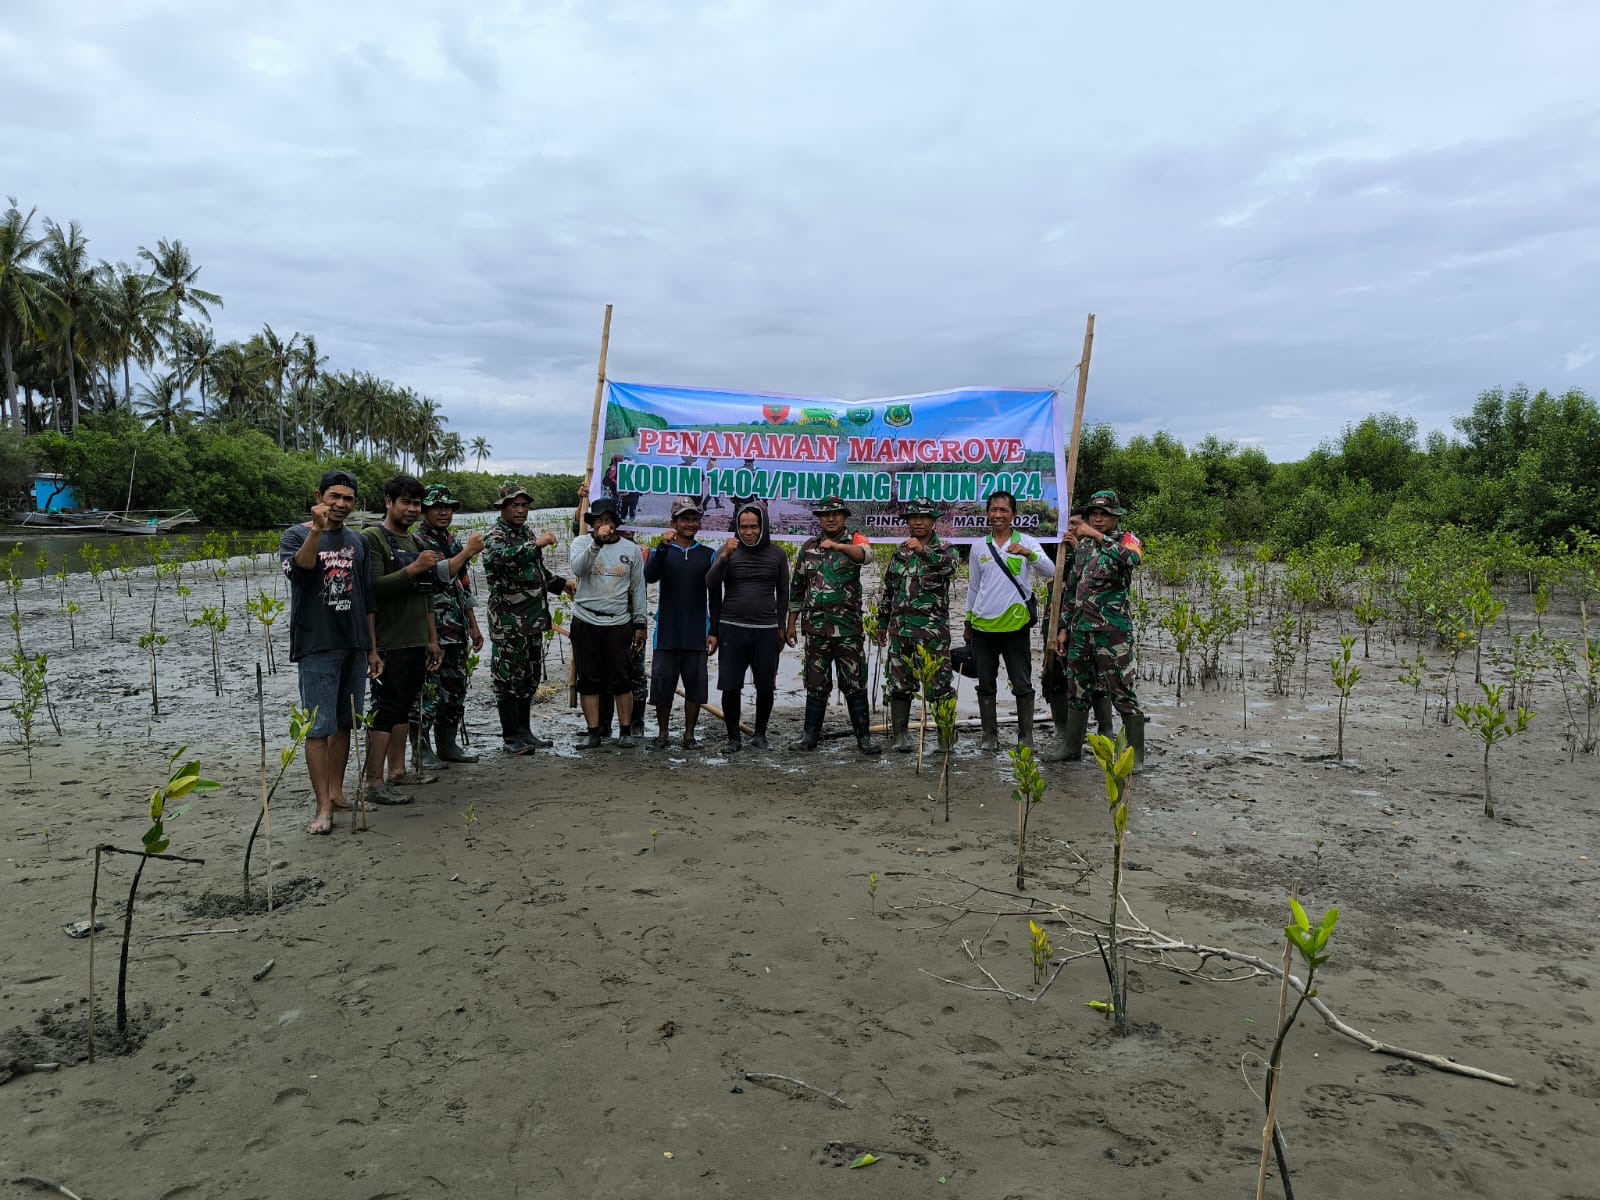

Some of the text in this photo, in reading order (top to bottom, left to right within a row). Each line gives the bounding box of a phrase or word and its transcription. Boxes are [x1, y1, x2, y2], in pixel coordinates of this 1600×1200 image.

[637, 428, 1025, 464] PENANAMAN MANGROVE
[617, 462, 1042, 502] KODIM 1404/PINRANG TAHUN 2024
[866, 514, 1040, 528] PINRA MARE 024
